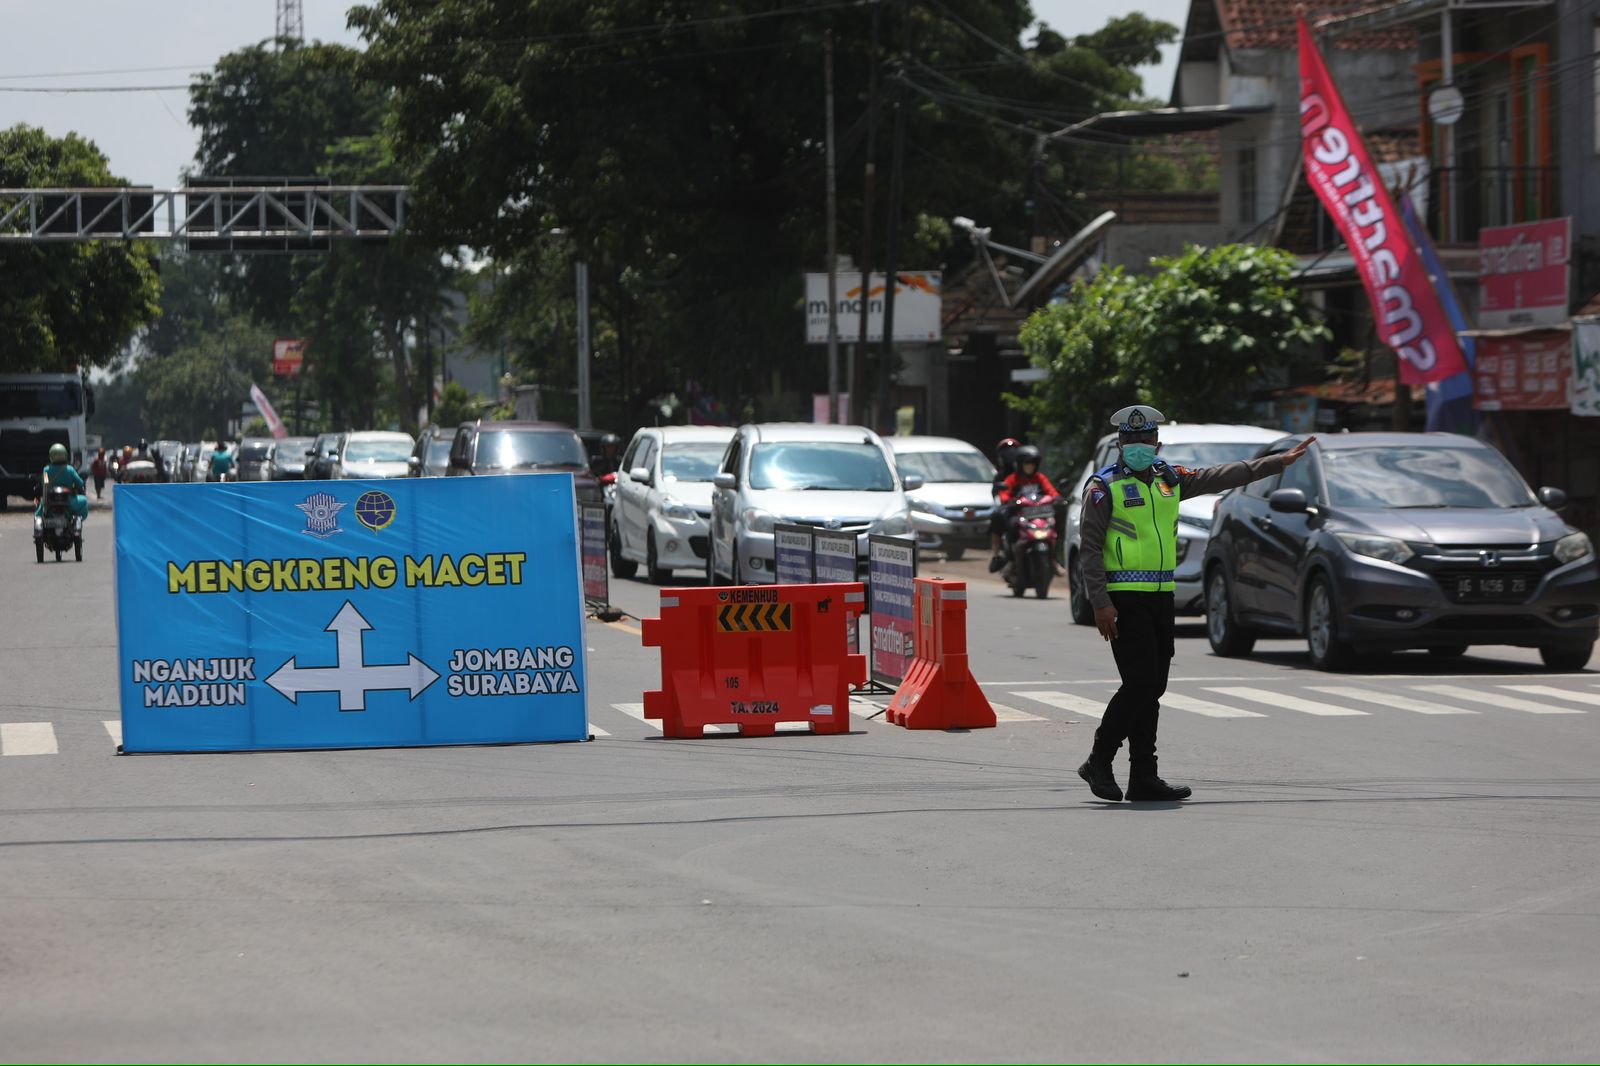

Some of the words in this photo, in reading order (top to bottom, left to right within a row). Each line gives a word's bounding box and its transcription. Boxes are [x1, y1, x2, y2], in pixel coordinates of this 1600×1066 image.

[167, 555, 397, 594] MENGKRENG
[405, 552, 526, 588] MACET
[730, 590, 778, 603] KEMENHUB
[873, 621, 904, 655] smartfren
[132, 657, 256, 684] NGANJUK
[448, 646, 574, 673] JOMBANG
[143, 682, 246, 708] MADIUN
[446, 670, 579, 698] SURABAYA
[725, 677, 739, 689] 105
[731, 701, 749, 714] TA.
[752, 701, 779, 714] 2024
